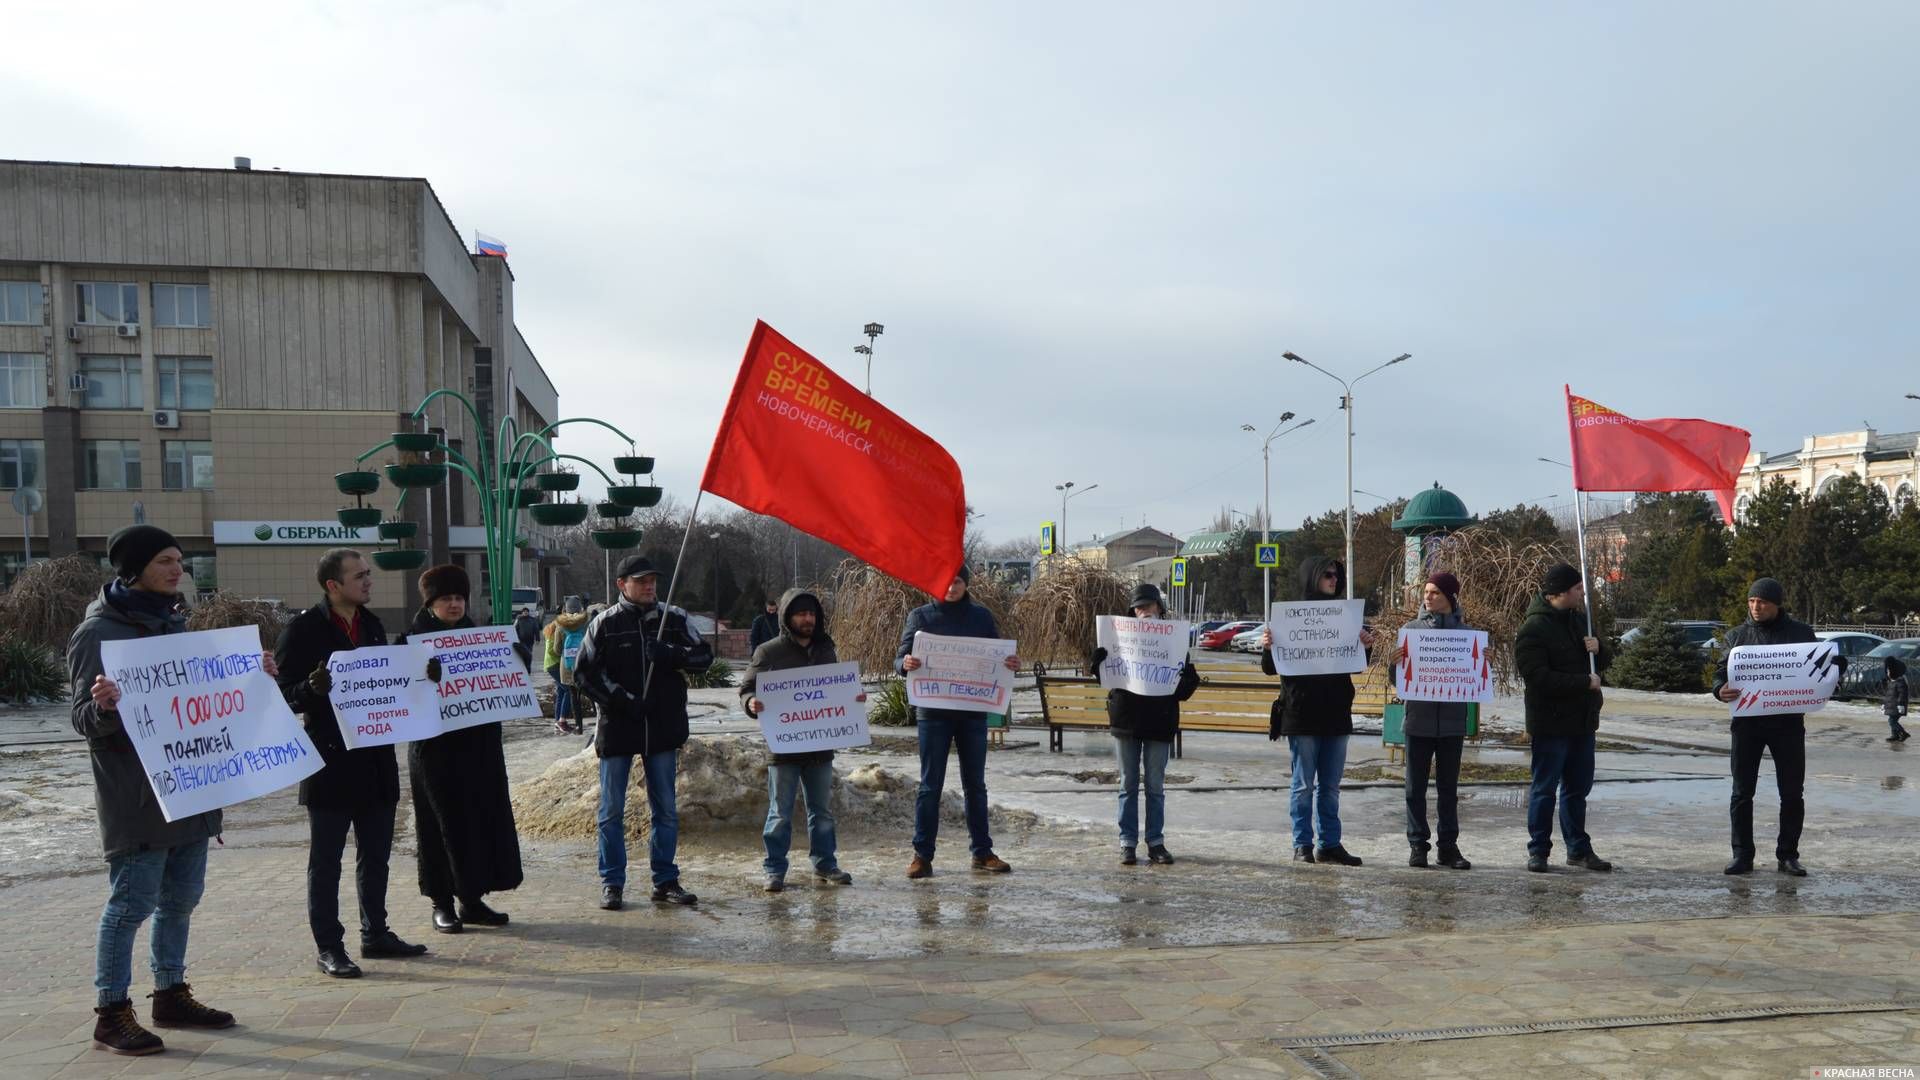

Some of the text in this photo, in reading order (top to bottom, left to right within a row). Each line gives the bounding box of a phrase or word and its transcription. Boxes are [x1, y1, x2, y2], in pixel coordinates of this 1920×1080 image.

[774, 351, 831, 391] СУТЬ
[764, 369, 873, 435] ВРЕМЕНИ
[757, 390, 873, 456] НОВОЧЕРКАССК
[277, 526, 361, 540] СБЕРБАНК
[422, 631, 509, 649] ОВЫШЕНИЕ
[1289, 628, 1340, 642] ОСТАНОВИ
[1420, 635, 1468, 643] Увеличение
[1419, 646, 1471, 654] пенсионного
[1734, 651, 1798, 660] Повышение
[131, 658, 189, 694] НУЖЕН
[224, 653, 262, 675] ОТВЕТ
[1734, 661, 1803, 671] пенсионного
[353, 675, 411, 692] реформу
[763, 672, 856, 692] КОНСТИТУЦИОННЫЙ
[1418, 675, 1476, 684] БЕЗРАБОТИЦА
[1735, 673, 1782, 682] возраста
[920, 680, 998, 698] НА ПЕНСИЮ!
[1763, 688, 1814, 697] снижение
[367, 708, 409, 722] против
[439, 693, 533, 720] КОНСТИТУЦИИ
[780, 706, 845, 723] ЗАЩИТИ
[134, 704, 156, 739] НА
[357, 723, 392, 736] РОДА
[163, 727, 234, 763] ПОДПИСЕЙ
